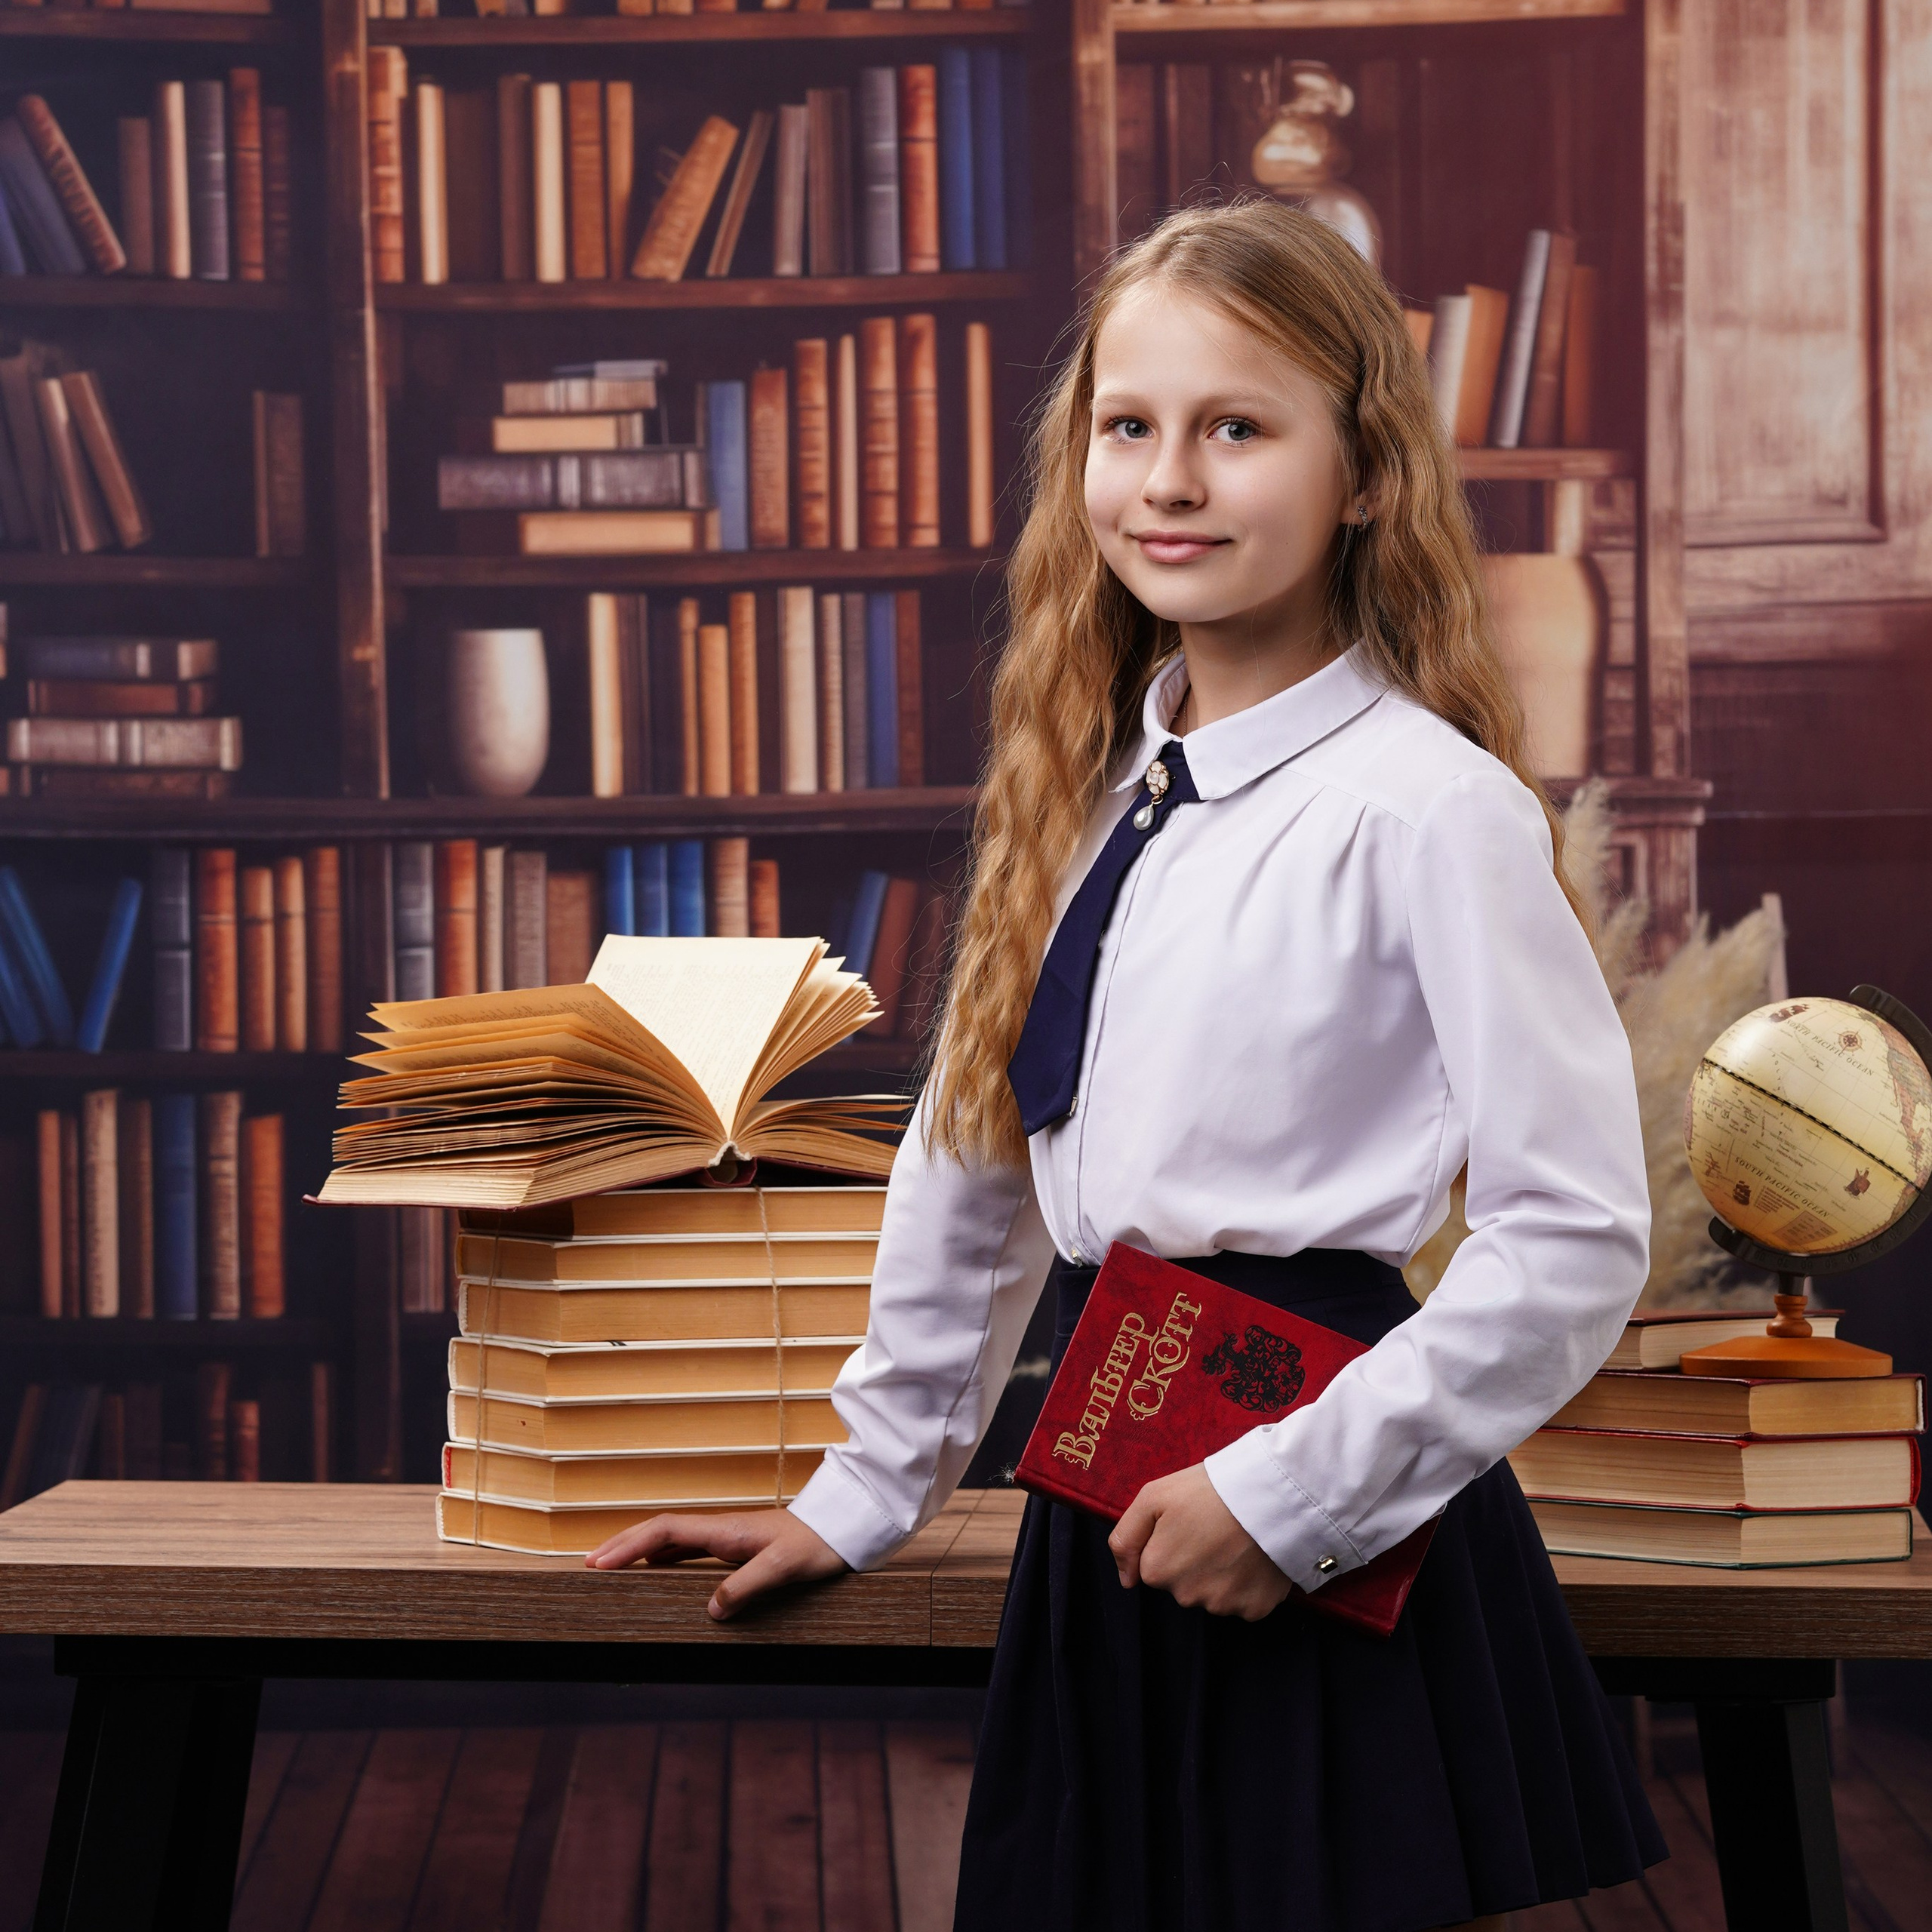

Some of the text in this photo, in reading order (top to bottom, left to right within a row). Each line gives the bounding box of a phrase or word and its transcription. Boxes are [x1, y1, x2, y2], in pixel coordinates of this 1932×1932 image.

[1786, 1020, 1875, 1076] NORTH PACIFIC OCEAN
[1734, 1156, 1764, 1177] SOUTH
[1764, 1175, 1801, 1199] PACIFIC
[1801, 1198, 1831, 1218] OCEAN
